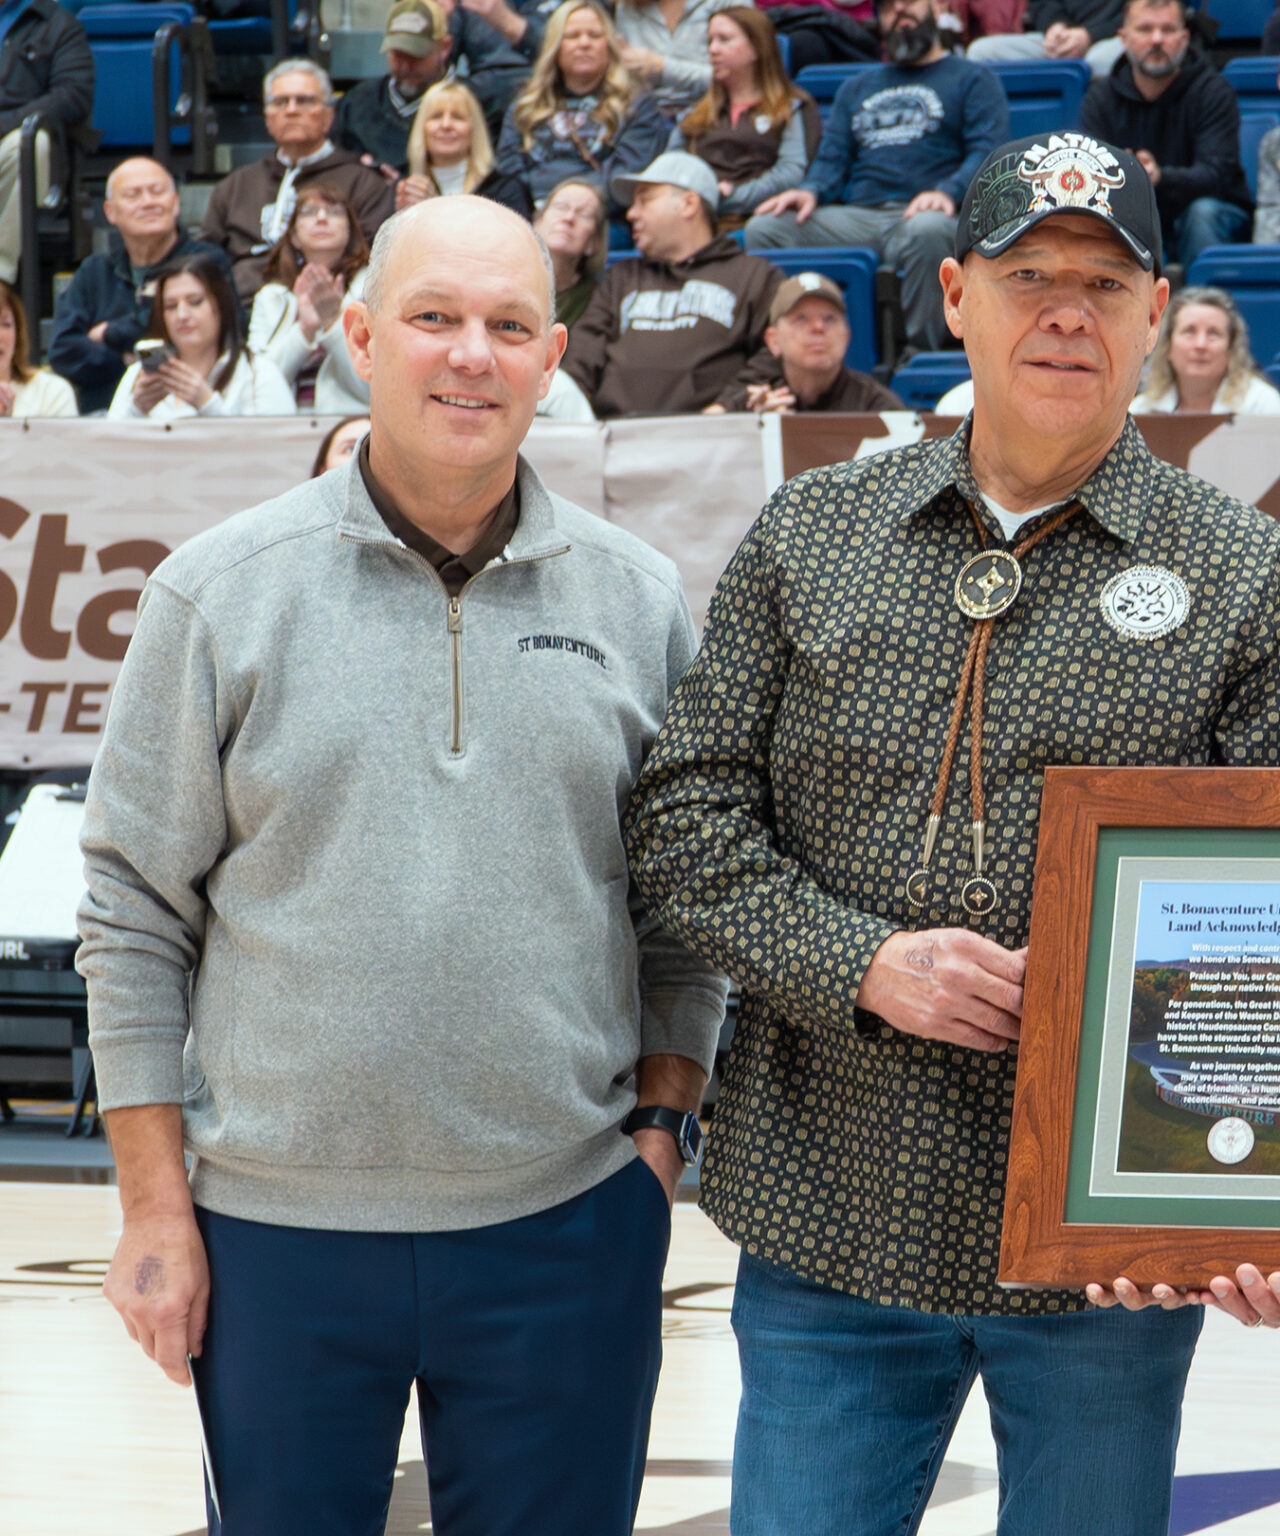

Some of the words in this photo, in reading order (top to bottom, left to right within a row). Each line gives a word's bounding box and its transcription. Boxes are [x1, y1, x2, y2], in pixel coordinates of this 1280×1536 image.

[1024, 133, 1119, 168] NATIVE
[518, 637, 530, 653] ST
[533, 635, 606, 669] BONAVENTURE
[1161, 903, 1178, 915] St.
[1181, 903, 1266, 915] Bonaventure
[1168, 920, 1201, 932] Land
[1192, 943, 1210, 952] With
[1212, 944, 1241, 954] respect
[1243, 944, 1257, 952] and
[1202, 955, 1226, 964] honor
[1227, 955, 1241, 964] the
[1242, 955, 1271, 964] Seneca
[1189, 972, 1220, 981] Praised
[1221, 972, 1231, 981] be
[1232, 972, 1250, 982] You,
[1190, 983, 1222, 994] through
[1238, 984, 1264, 992] native
[1168, 1000, 1182, 1008] For
[1183, 1000, 1233, 1011] generations,
[1234, 1000, 1248, 1009] the
[1249, 1001, 1271, 1010] Great
[1164, 1011, 1180, 1019] and
[1180, 1011, 1213, 1022] Keepers
[1214, 1011, 1224, 1020] of
[1224, 1011, 1238, 1020] the
[1239, 1011, 1272, 1020] Western
[1166, 1021, 1197, 1031] historic
[1197, 1022, 1262, 1032] Haudenosaunee
[1157, 1032, 1177, 1041] have
[1178, 1033, 1198, 1042] been
[1199, 1033, 1213, 1042] the
[1214, 1033, 1251, 1042] stewards
[1252, 1033, 1261, 1042] of
[1261, 1034, 1275, 1042] the
[1159, 1043, 1170, 1053] St.
[1171, 1044, 1224, 1053] Bonaventure
[1224, 1044, 1265, 1055] University
[1189, 1061, 1201, 1070] As
[1201, 1063, 1214, 1071] we
[1214, 1061, 1246, 1073] journey
[1181, 1075, 1198, 1083] may
[1212, 1073, 1238, 1084] polish
[1173, 1084, 1196, 1093] chain
[1197, 1084, 1207, 1093] of
[1207, 1084, 1250, 1095] friendship,
[1251, 1084, 1260, 1093] in
[1183, 1095, 1240, 1105] reconciliation,
[1241, 1096, 1258, 1104] and
